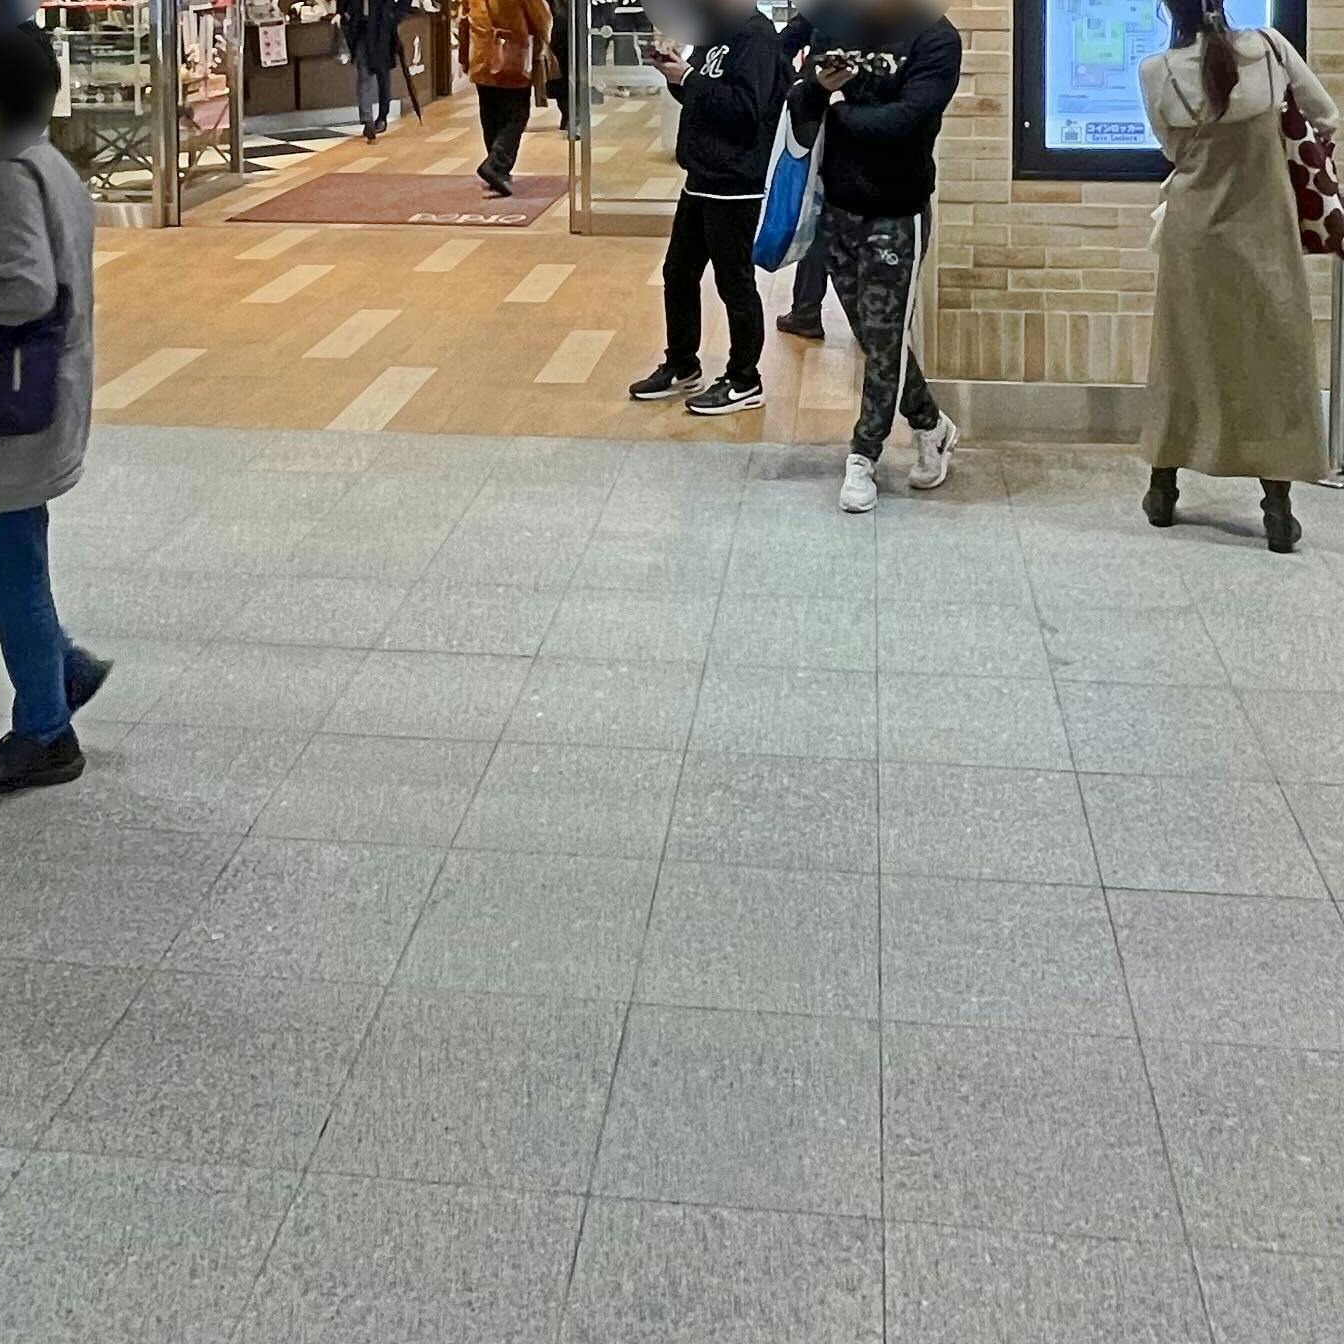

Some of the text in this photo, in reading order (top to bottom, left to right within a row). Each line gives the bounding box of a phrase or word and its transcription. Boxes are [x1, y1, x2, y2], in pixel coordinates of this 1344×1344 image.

[1087, 122, 1144, 133] コインロッカー
